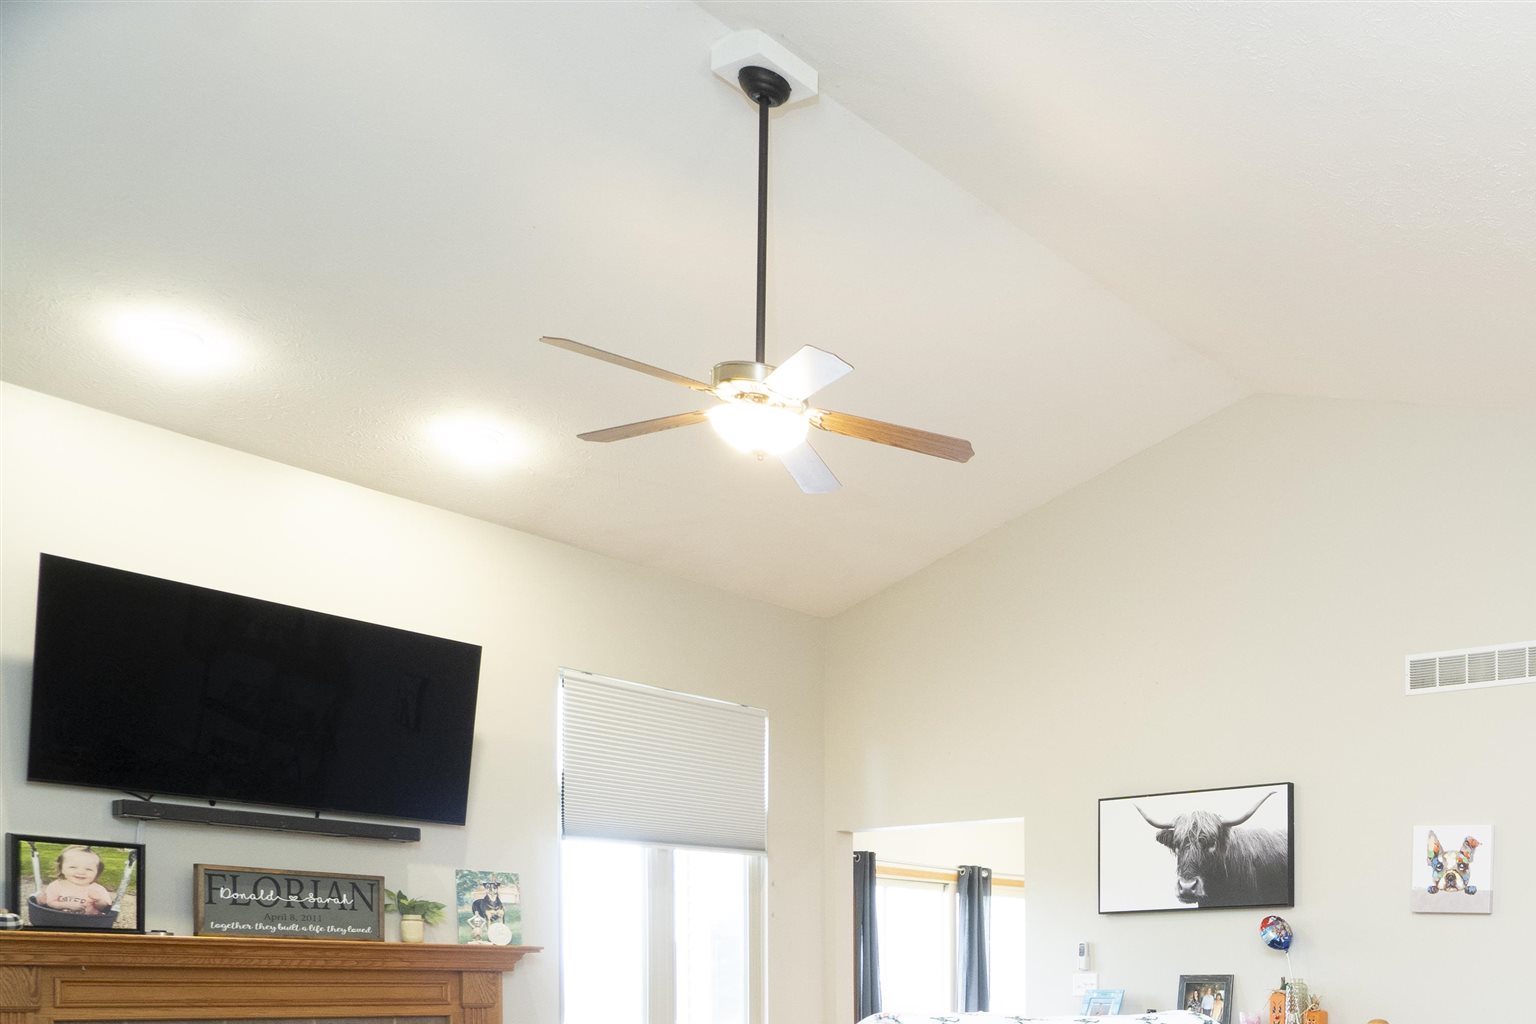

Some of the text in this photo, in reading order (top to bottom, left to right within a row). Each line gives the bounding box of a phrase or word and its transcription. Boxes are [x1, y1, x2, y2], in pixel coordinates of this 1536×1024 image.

[204, 872, 377, 912] FLORIAN
[219, 887, 354, 905] Donald Sarah
[263, 912, 287, 923] April
[210, 921, 254, 932] together
[255, 922, 277, 933] they
[277, 923, 300, 932] built
[309, 925, 325, 934] life
[326, 925, 347, 935] they
[347, 925, 373, 934] loved
